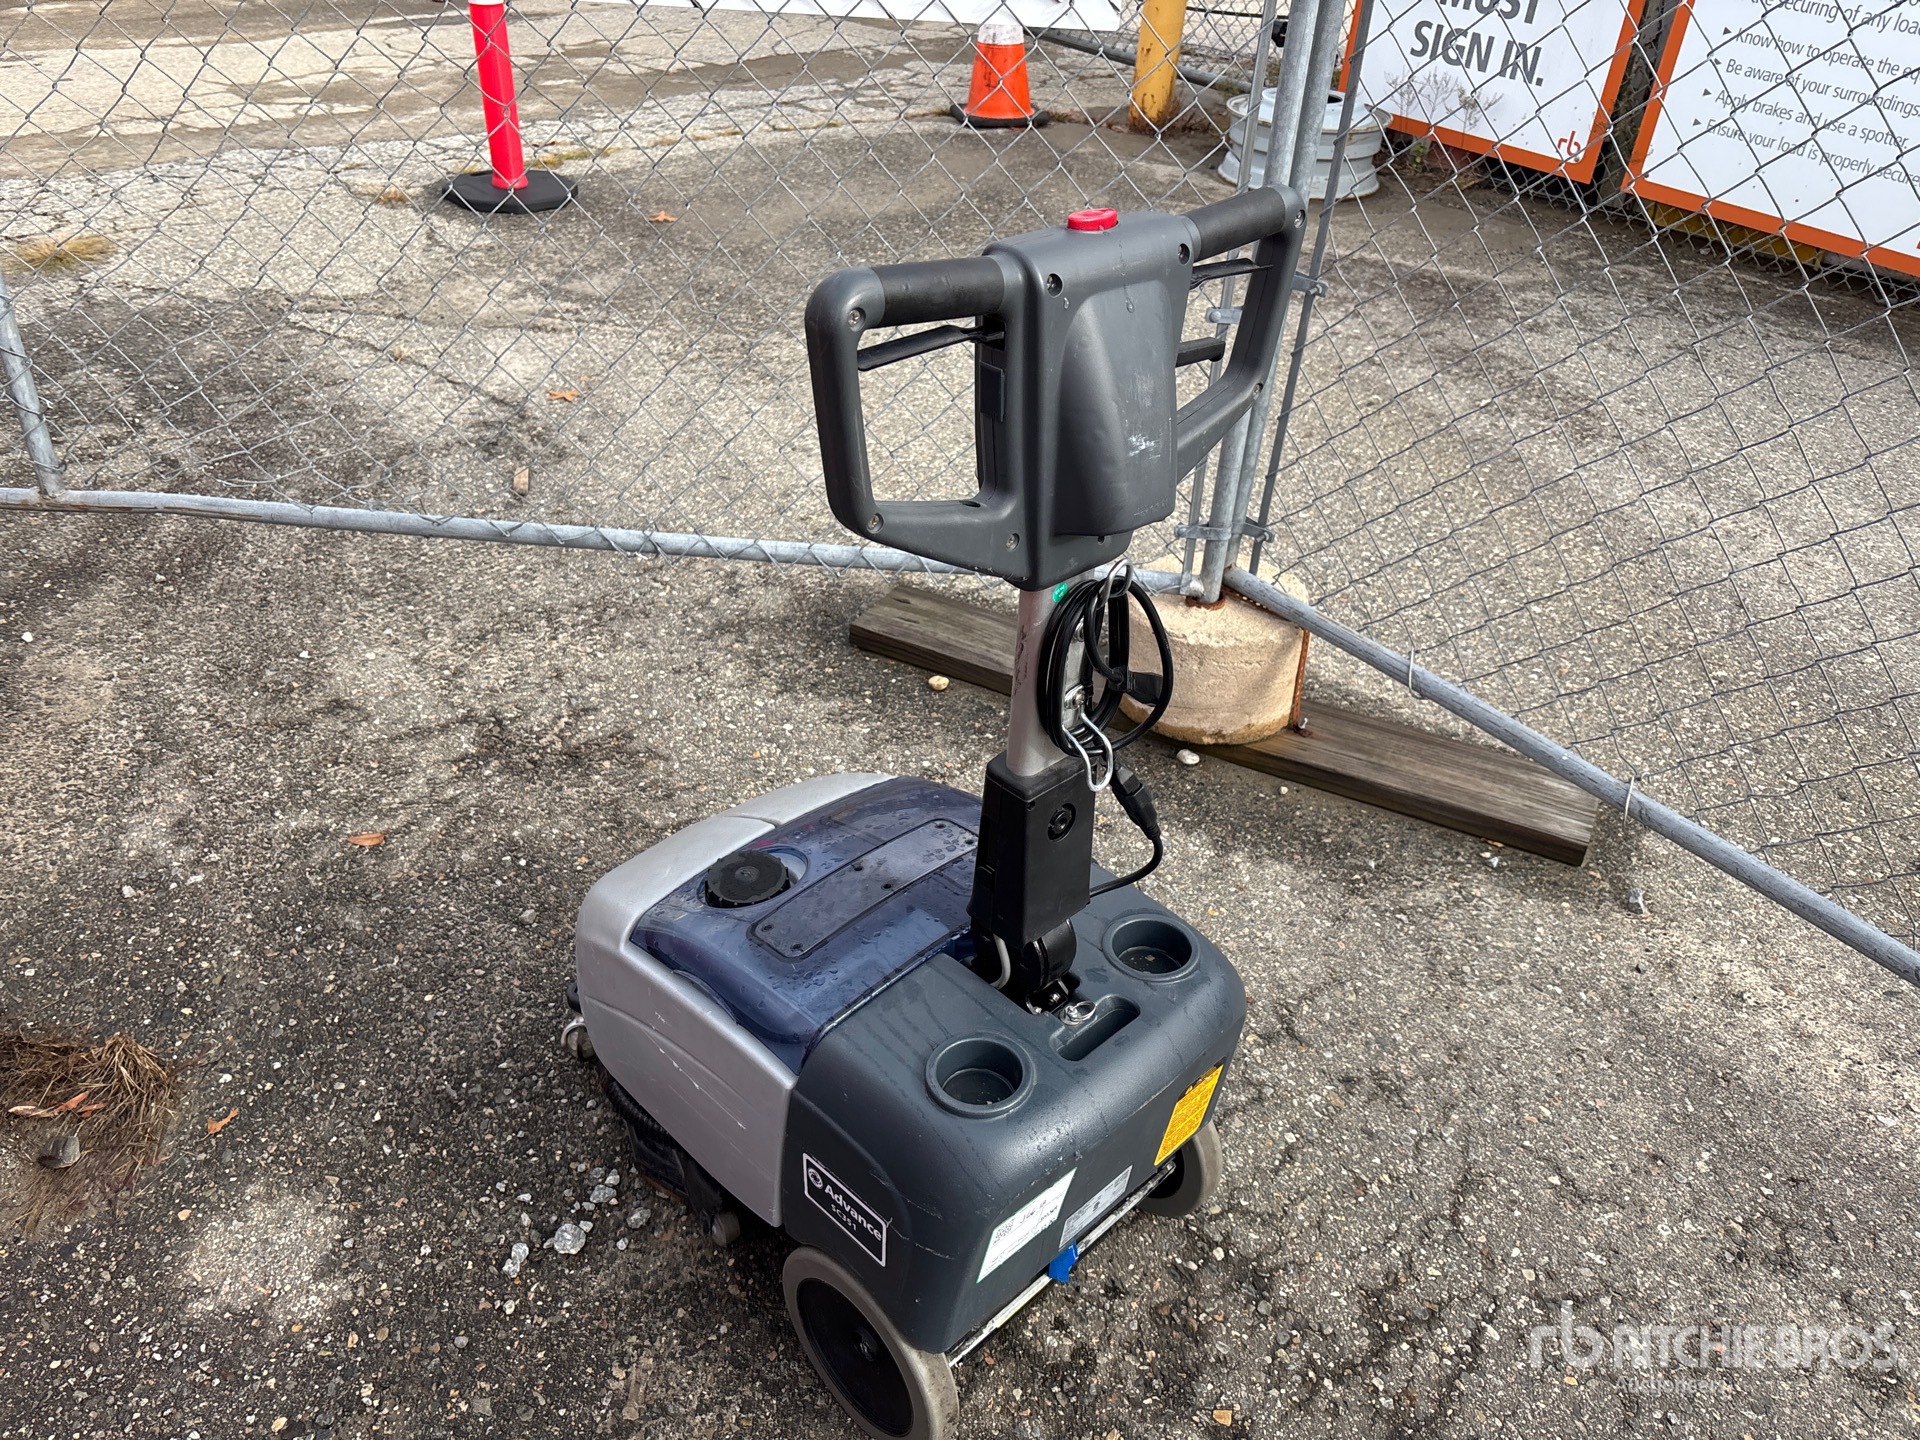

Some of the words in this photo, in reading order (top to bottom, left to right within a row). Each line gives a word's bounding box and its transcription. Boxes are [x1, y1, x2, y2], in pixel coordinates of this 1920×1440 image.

[1439, 0, 1539, 24] ST
[1843, 5, 1863, 23] of
[1861, 12, 1893, 33] any
[1893, 12, 1920, 36] loa
[1410, 20, 1495, 73] SIGN
[1499, 40, 1545, 87] IN.
[1726, 58, 1742, 76] Be
[1744, 65, 1784, 84] aware
[1785, 73, 1803, 87] of
[1799, 78, 1831, 96] your
[1736, 28, 1774, 50] Know
[1774, 35, 1802, 55] how
[1806, 44, 1821, 58] to
[1822, 50, 1874, 69] operate
[1878, 58, 1900, 76] the
[1902, 66, 1920, 85] eq
[1715, 89, 1748, 113] Apply
[1752, 99, 1794, 121] brakes
[1795, 111, 1821, 127] and
[1823, 118, 1846, 134] use
[1848, 122, 1857, 137] a
[1859, 126, 1908, 150] spotter.
[1556, 131, 1581, 156] rb
[1706, 118, 1746, 142] Ensure
[1746, 132, 1778, 150] your
[1777, 137, 1806, 157] load
[1807, 144, 1819, 160] is
[1818, 152, 1876, 179] properly
[1876, 166, 1920, 188] secure
[824, 1184, 882, 1241] Advance
[830, 1204, 857, 1231] SC351
